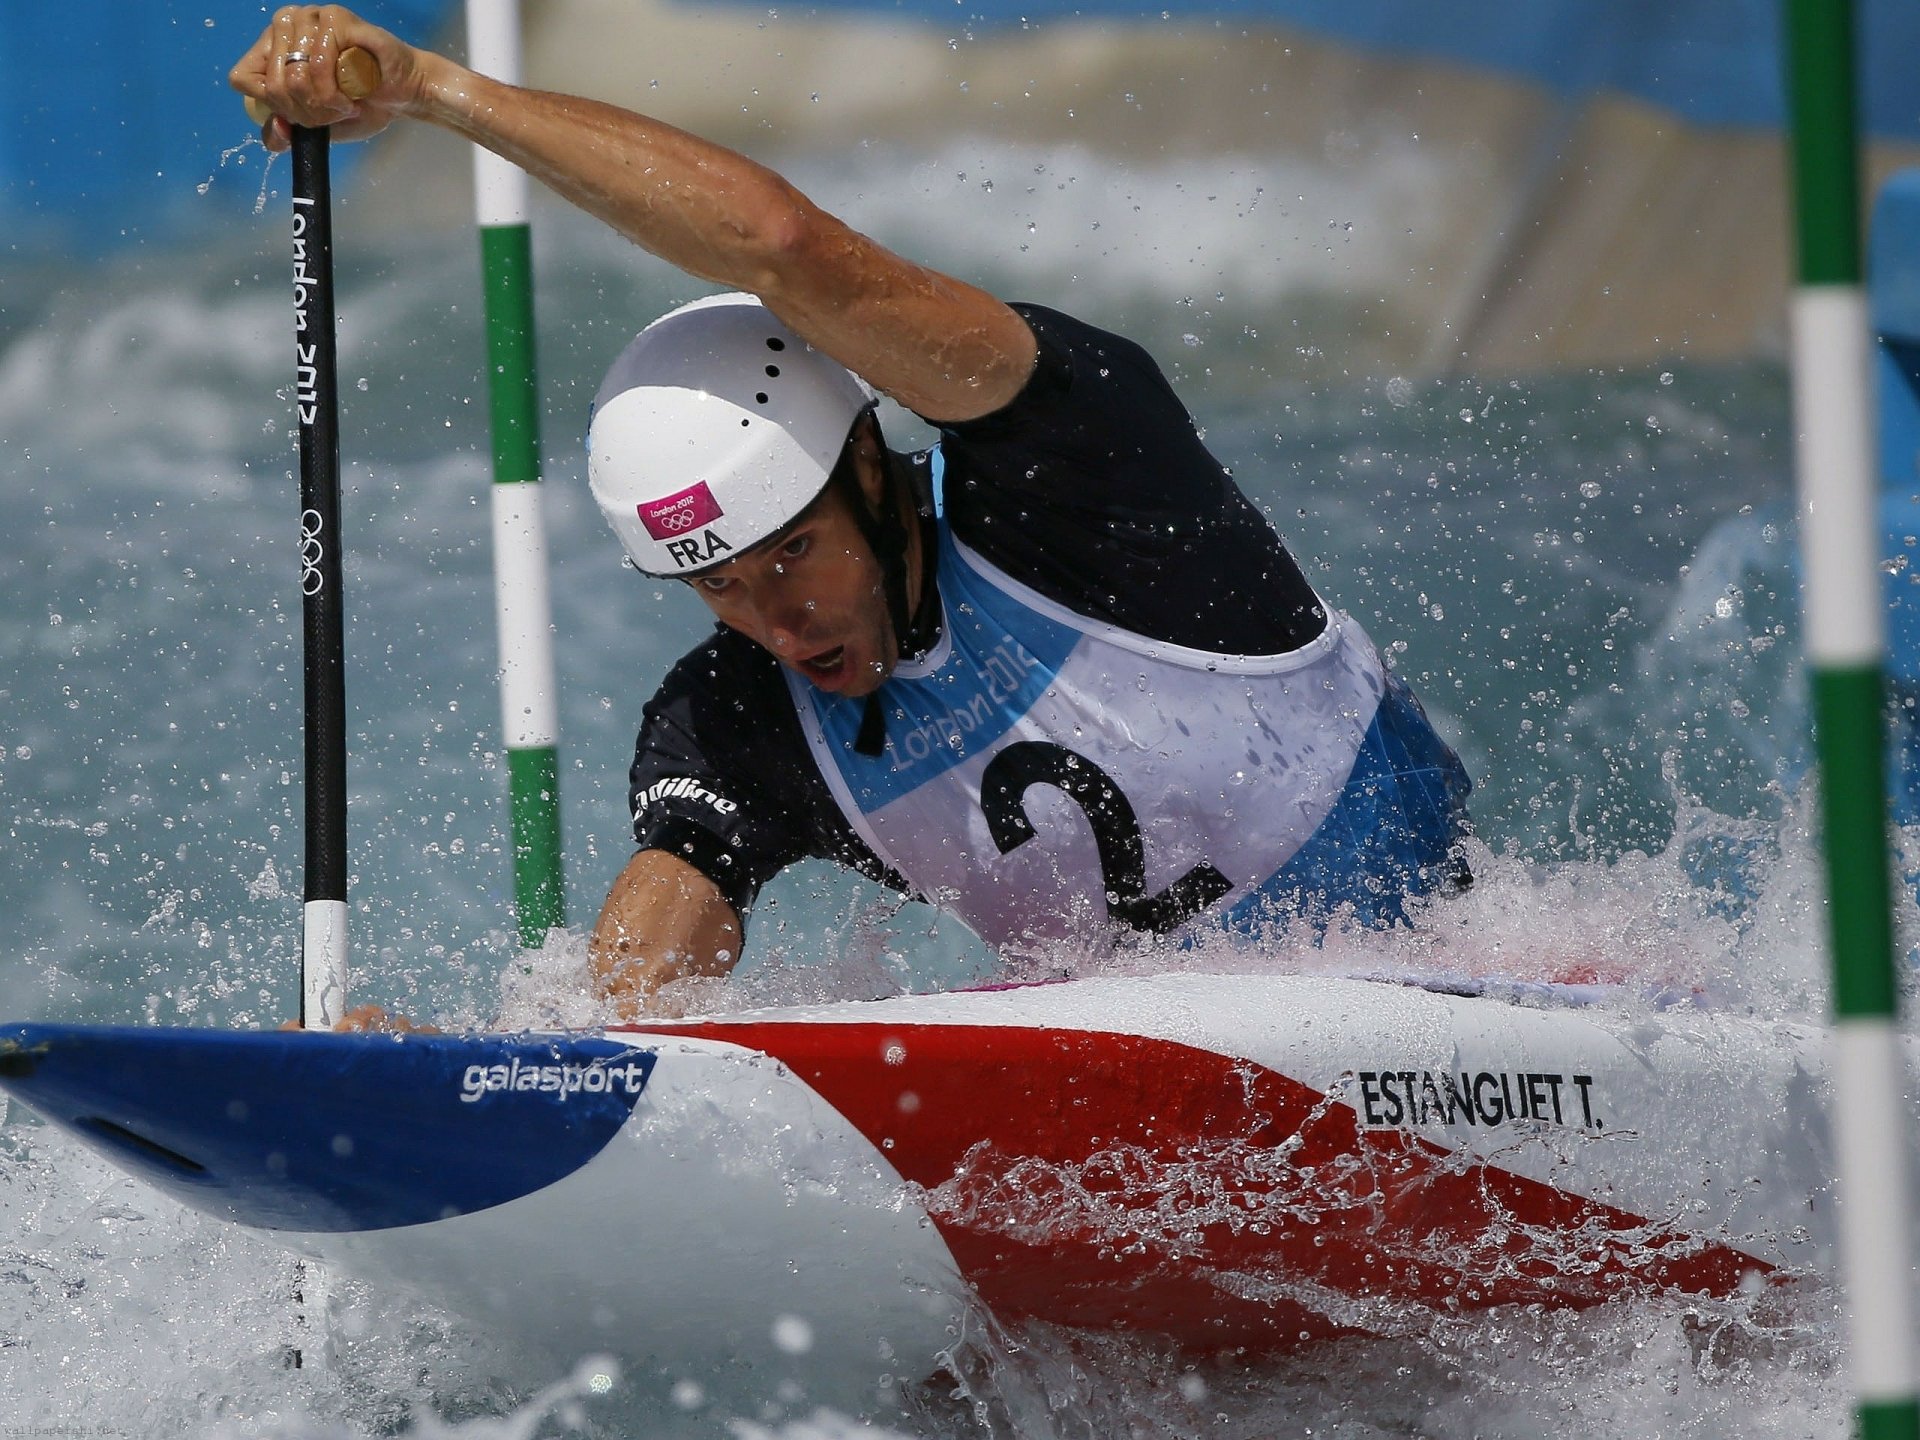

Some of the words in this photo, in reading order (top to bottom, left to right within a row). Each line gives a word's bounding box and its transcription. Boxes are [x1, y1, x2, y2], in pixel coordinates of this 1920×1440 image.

[293, 197, 318, 331] London
[296, 343, 318, 425] 2012
[650, 504, 677, 518] London
[676, 496, 695, 509] 2012
[665, 529, 733, 568] FRA
[980, 740, 1235, 936] 2
[459, 1056, 643, 1102] galasport
[1358, 1071, 1563, 1127] ESTANGUET
